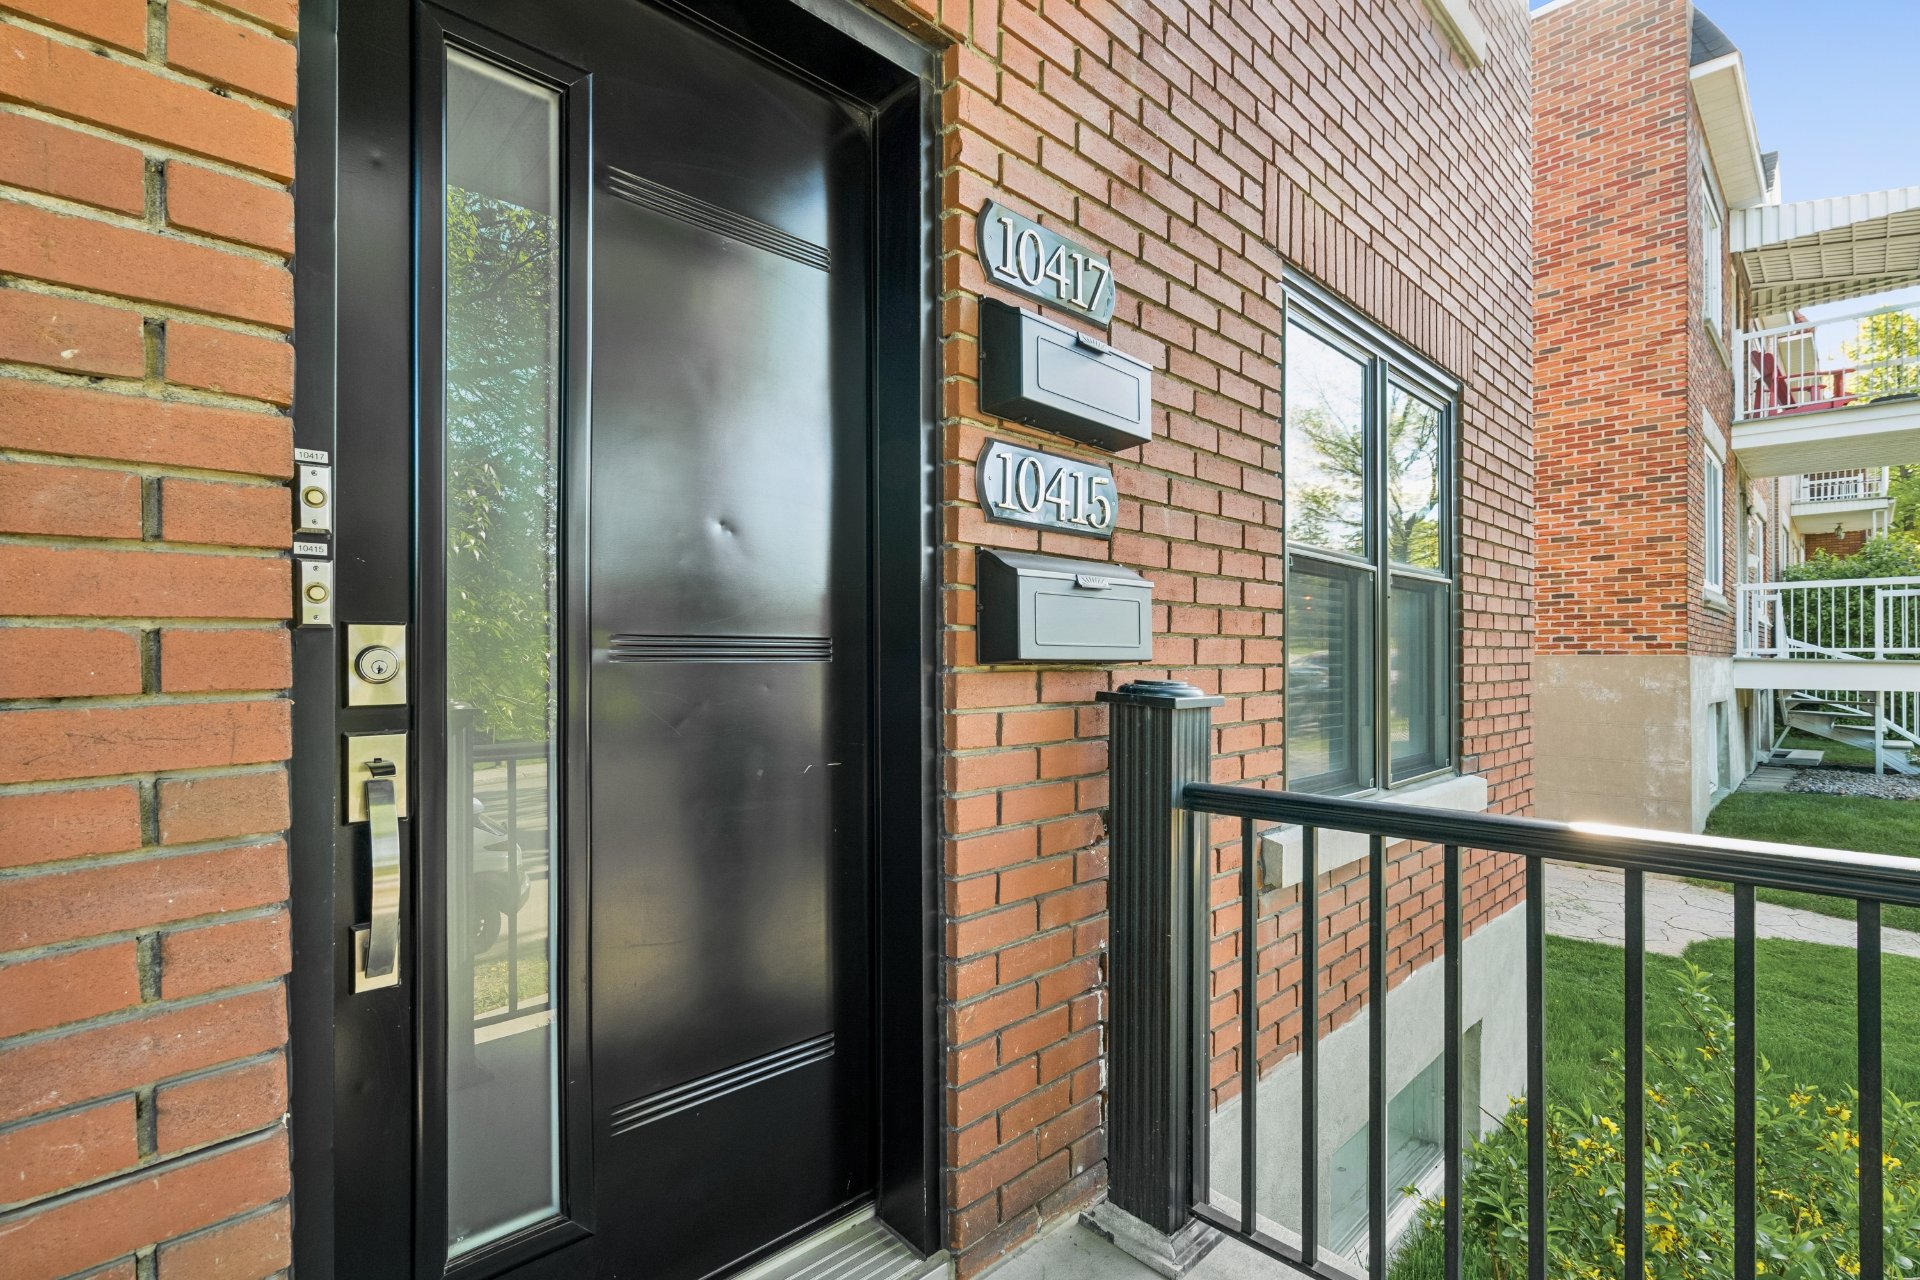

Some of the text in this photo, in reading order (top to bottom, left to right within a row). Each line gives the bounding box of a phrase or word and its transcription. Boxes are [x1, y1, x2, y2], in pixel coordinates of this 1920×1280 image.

[995, 216, 1111, 312] 10417
[299, 451, 325, 460] 10417
[994, 452, 1111, 529] 10415
[298, 544, 324, 553] 10415
